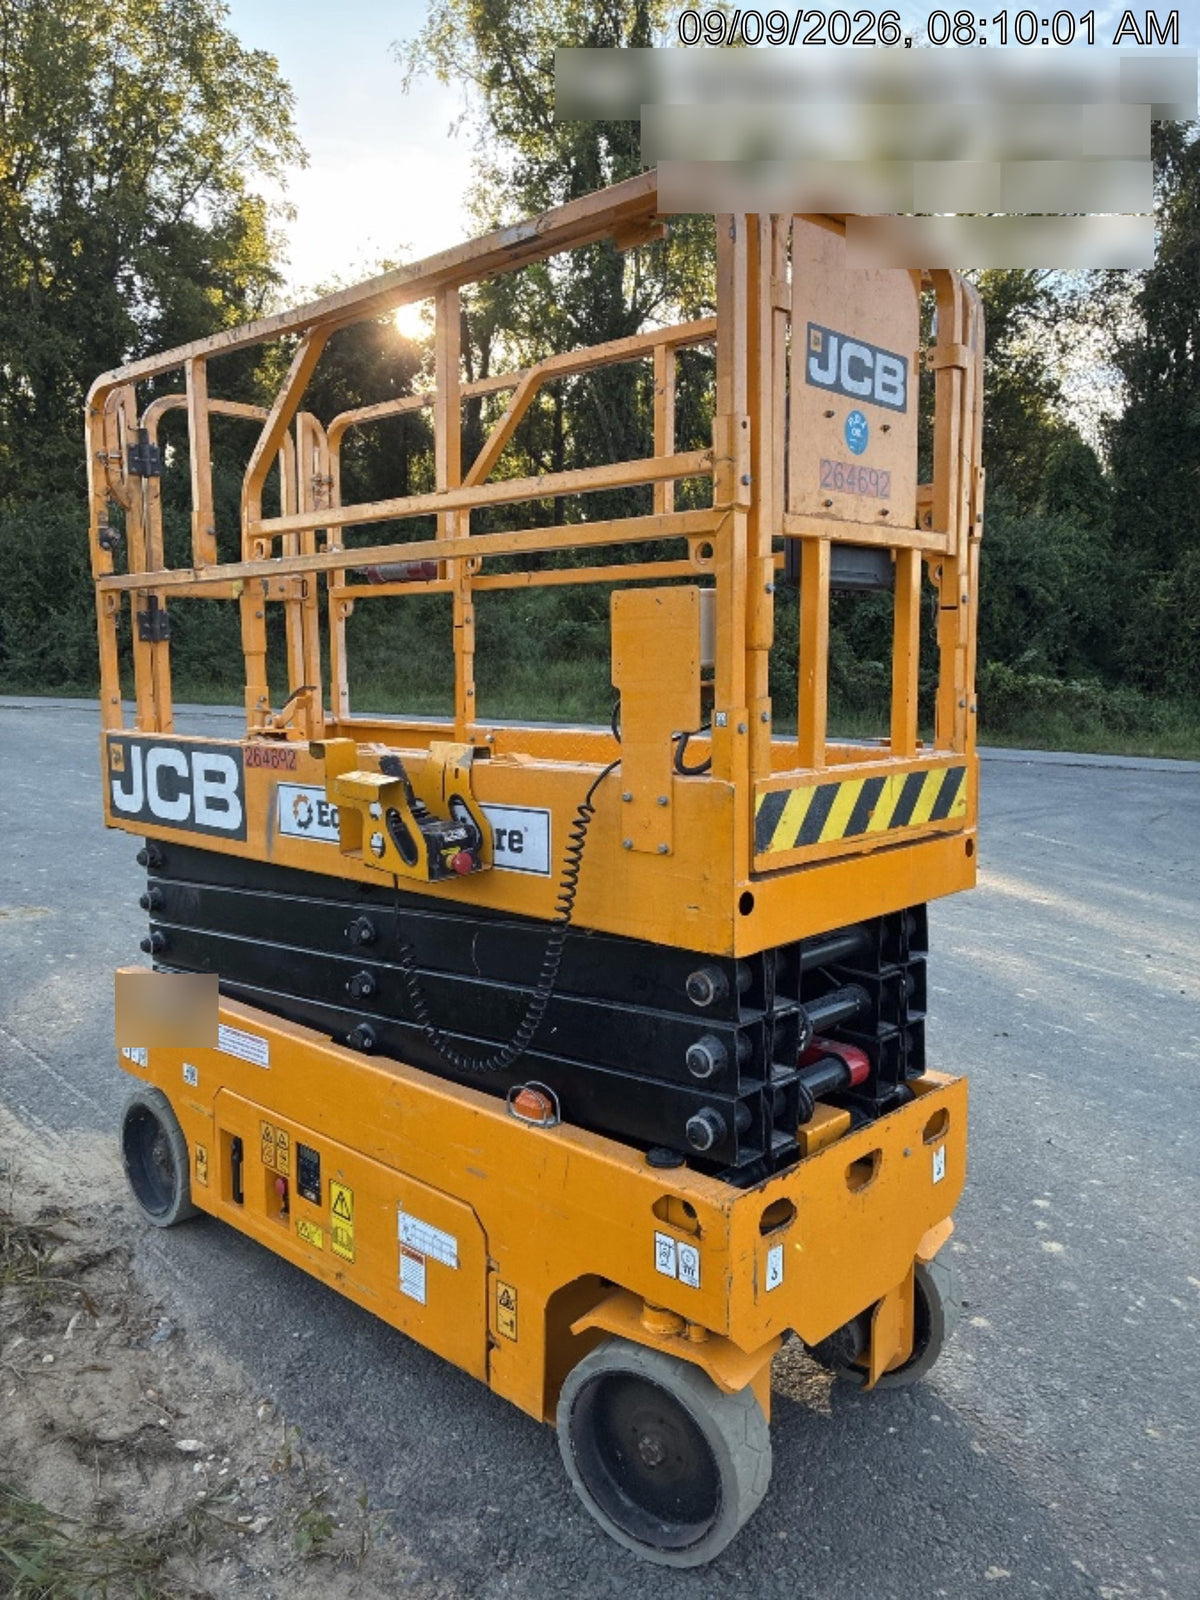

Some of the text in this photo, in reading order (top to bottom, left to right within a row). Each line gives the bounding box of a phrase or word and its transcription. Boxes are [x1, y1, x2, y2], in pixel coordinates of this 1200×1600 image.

[809, 335, 905, 405] JCB
[821, 461, 891, 498] 264692
[244, 745, 297, 770] 264692
[111, 745, 243, 830] JCB
